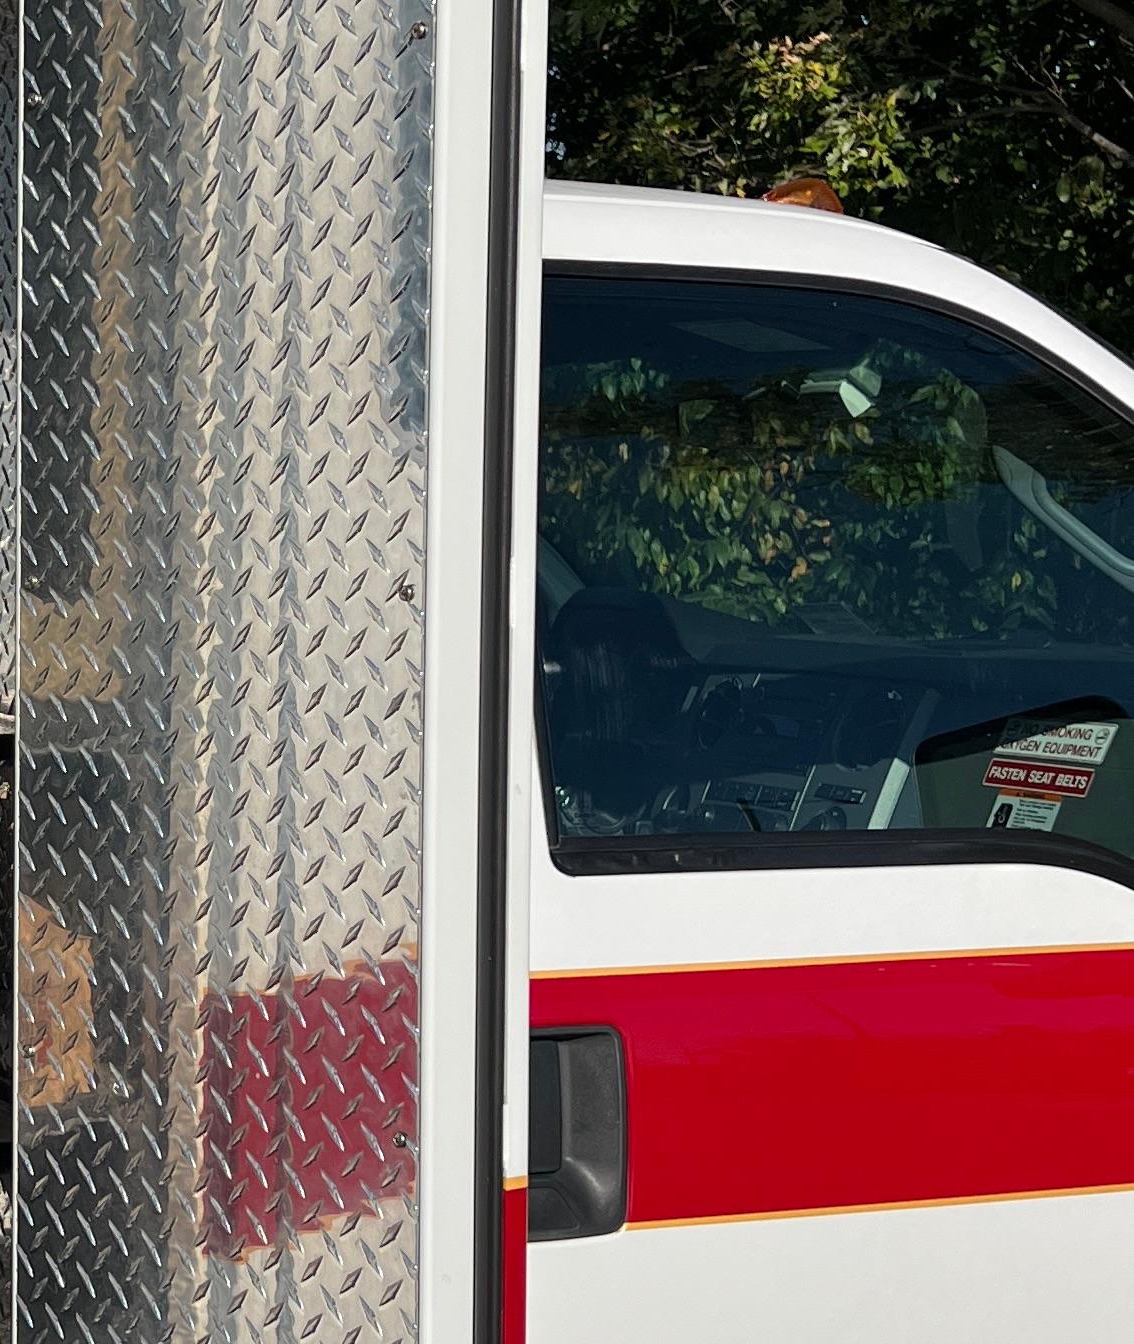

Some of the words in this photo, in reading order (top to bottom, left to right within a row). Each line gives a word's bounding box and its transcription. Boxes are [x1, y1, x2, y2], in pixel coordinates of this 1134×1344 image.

[1043, 742, 1101, 758] EQUIPMENT
[989, 766, 1027, 781] FASTEN
[1028, 770, 1055, 784] SEAT
[1055, 774, 1088, 789] BELTS
